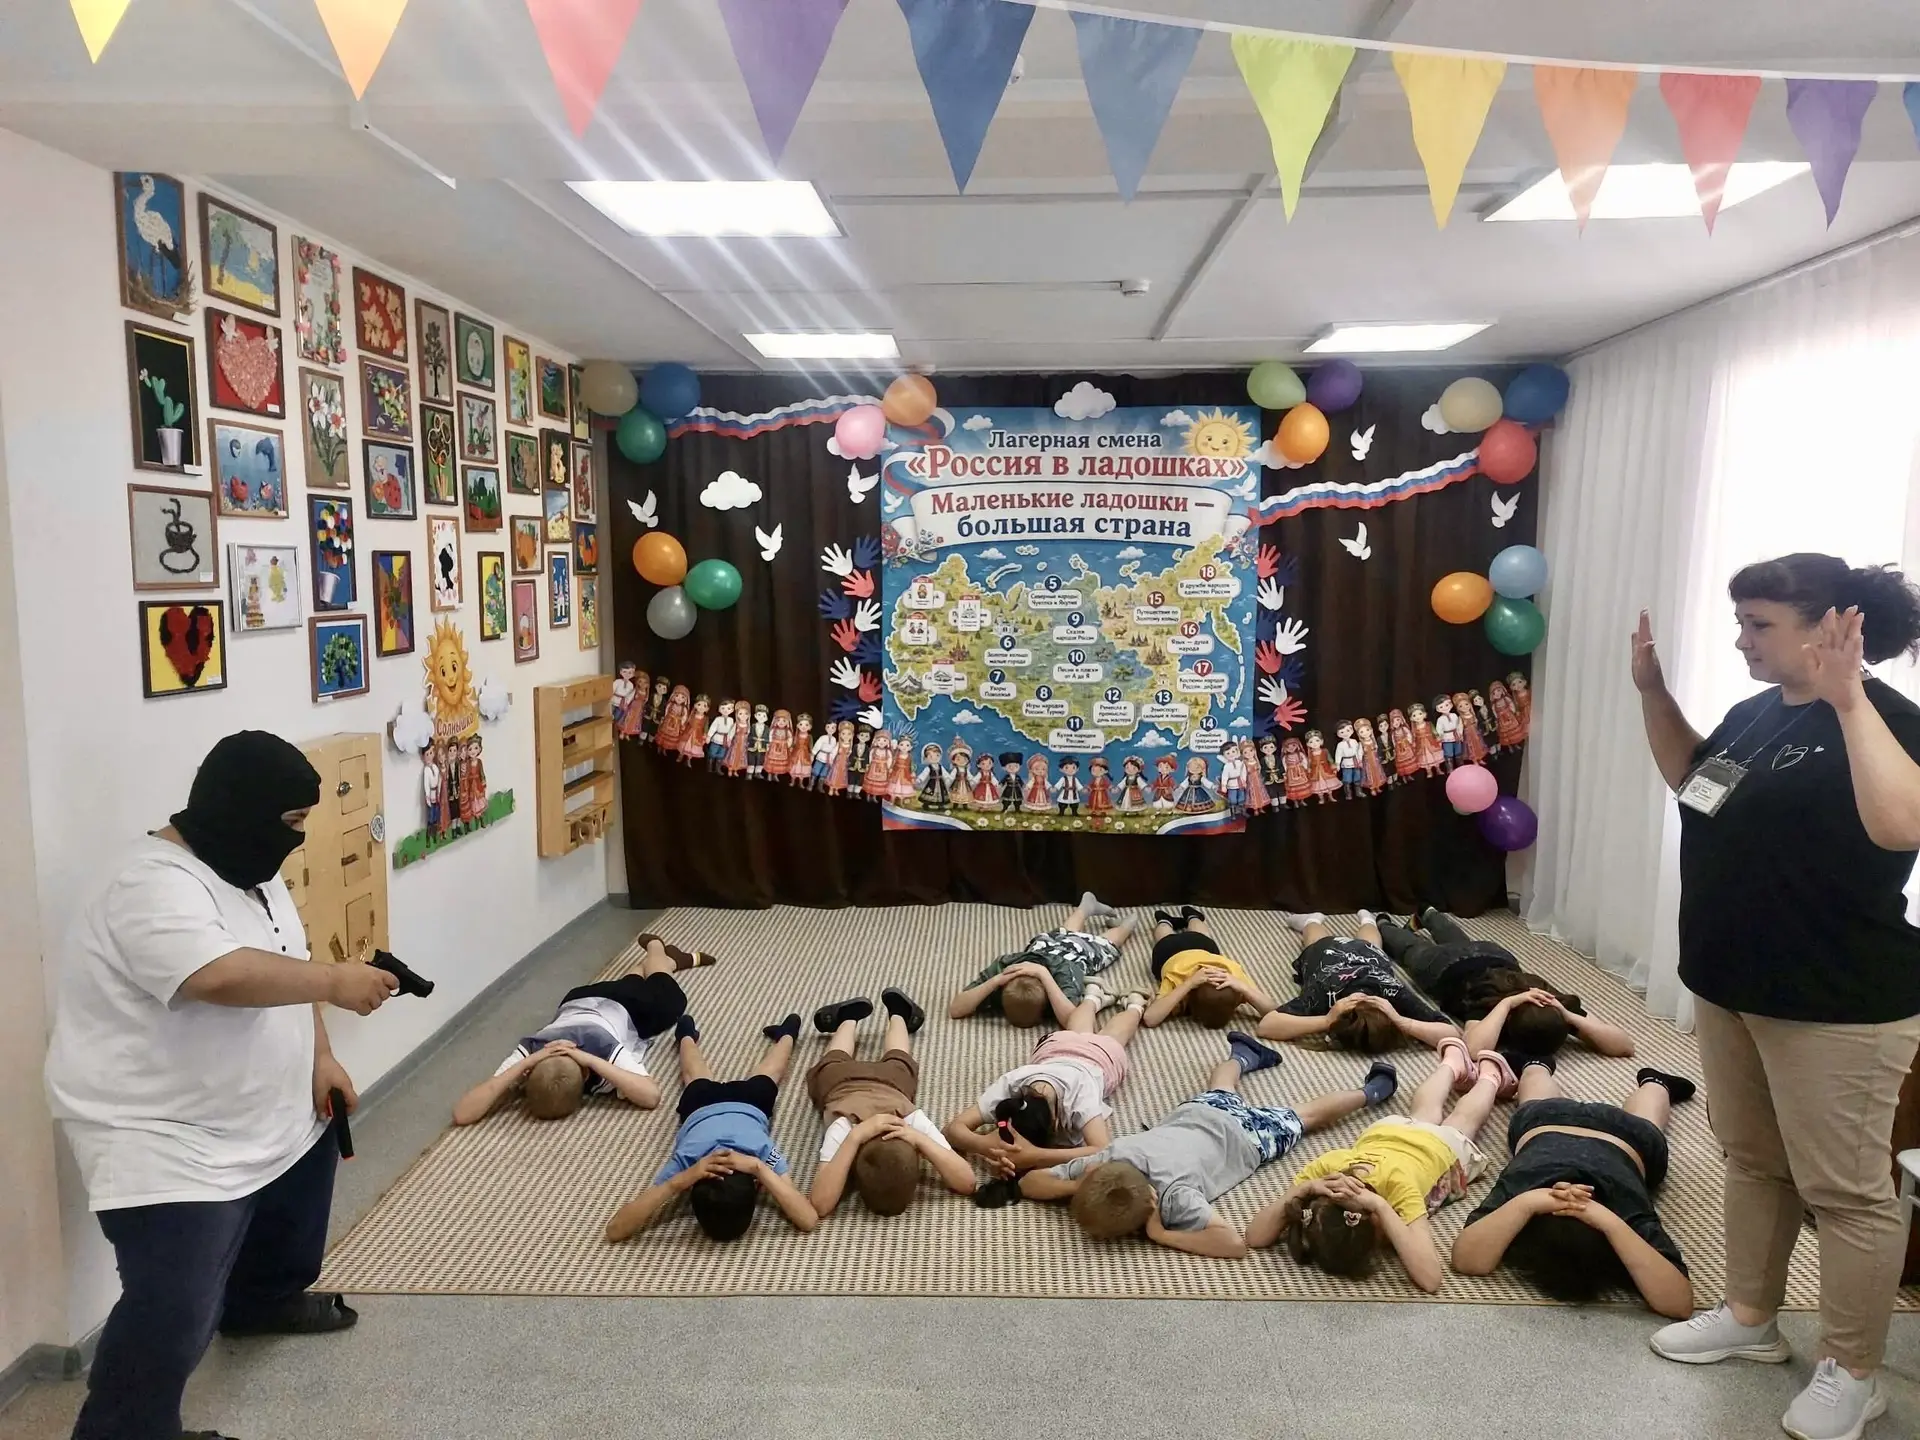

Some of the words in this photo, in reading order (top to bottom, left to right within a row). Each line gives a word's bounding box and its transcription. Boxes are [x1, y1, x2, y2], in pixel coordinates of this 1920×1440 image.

[988, 431, 1090, 452] Лагерная
[1097, 434, 1162, 448] смена
[907, 447, 1042, 479] «Россия
[1052, 456, 1070, 476] в
[1077, 456, 1245, 480] ладошках»
[931, 492, 1074, 515] Маленькие
[1080, 493, 1189, 512] ладошки
[957, 514, 1085, 537] большая
[1094, 516, 1192, 540] страна
[1201, 566, 1214, 576] 18
[1049, 578, 1057, 589] 5
[1150, 593, 1162, 605] 15
[1071, 614, 1080, 625] 9
[1183, 624, 1197, 635] 16
[1003, 638, 1012, 648] 6
[1070, 652, 1083, 662] 10
[1197, 663, 1209, 673] 17
[993, 671, 1001, 682] 7
[1040, 688, 1048, 698] 8
[1107, 690, 1120, 701] 12
[1157, 692, 1171, 703] 13
[436, 712, 474, 737] Солнышко
[1069, 719, 1079, 728] 11
[1202, 719, 1214, 727] 14
